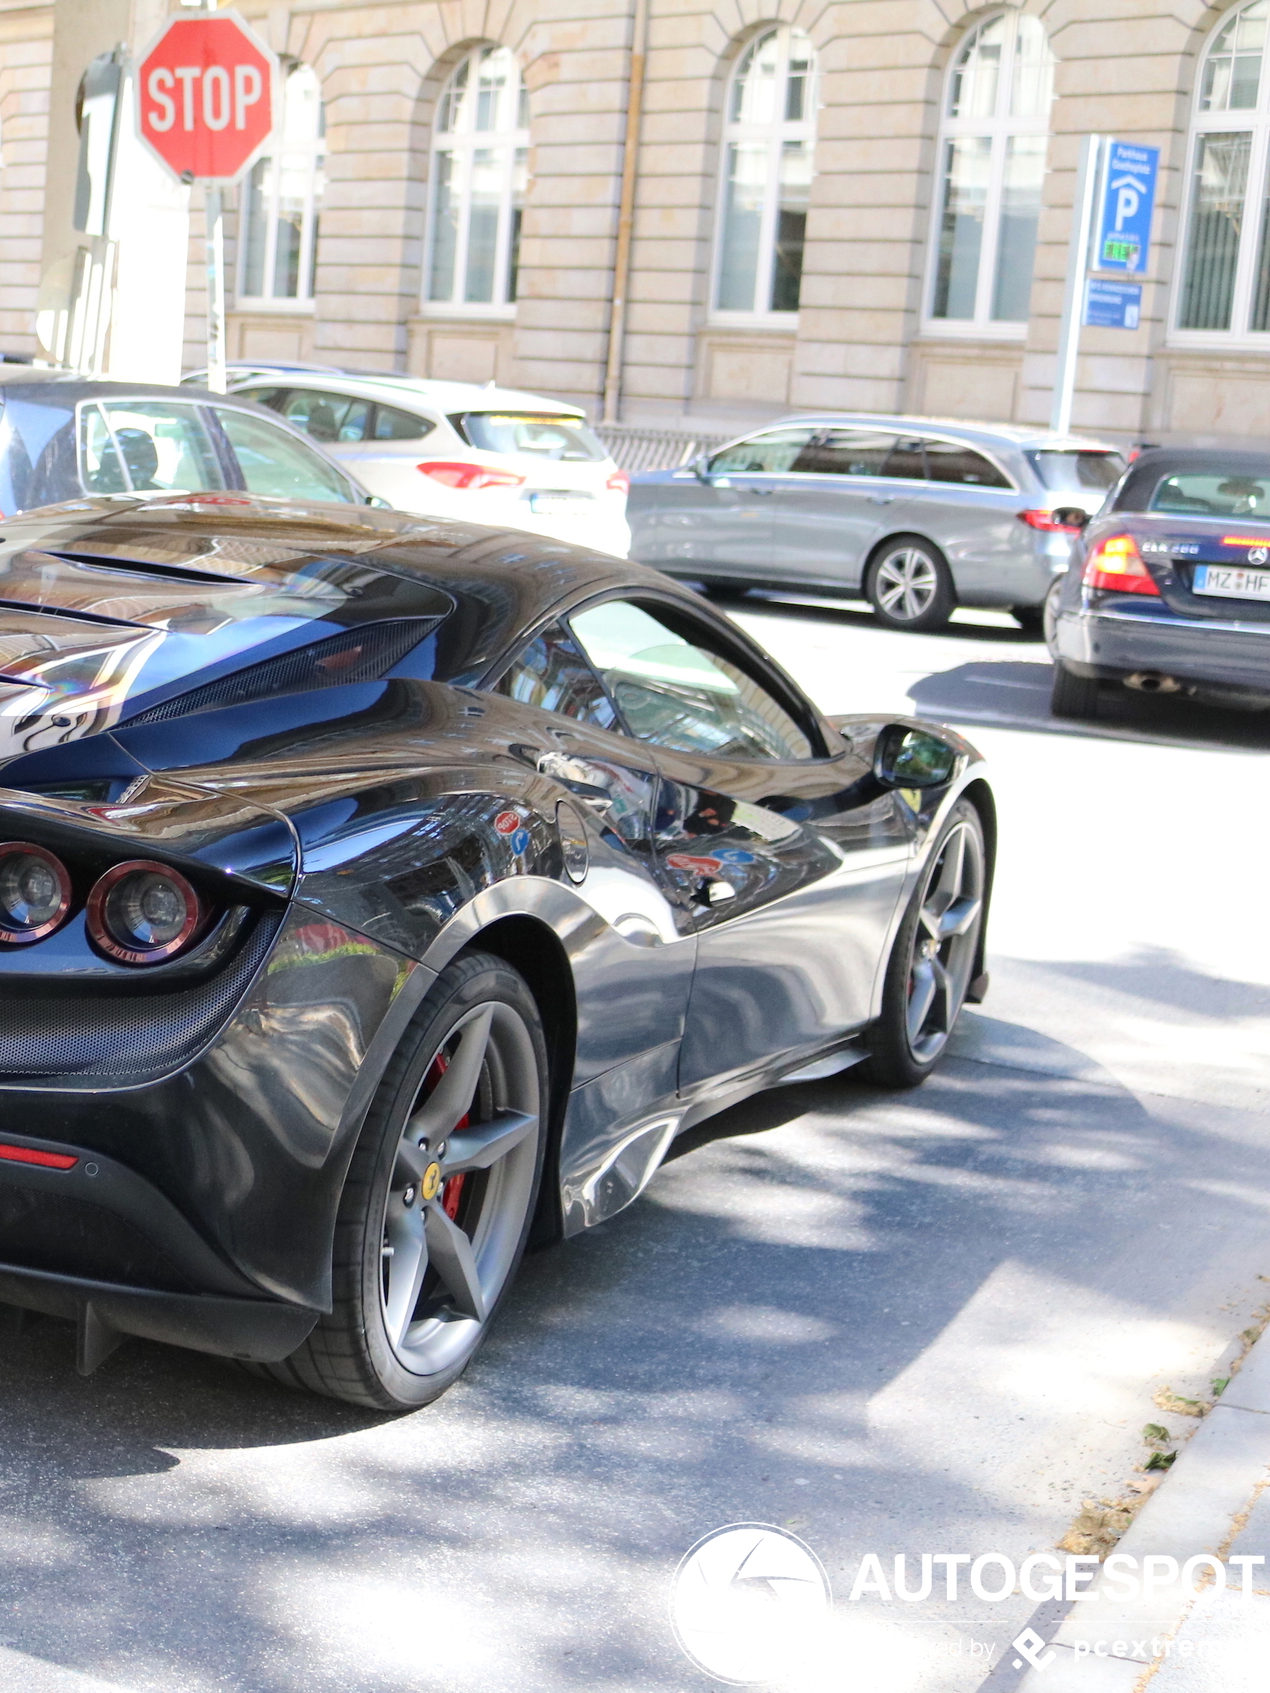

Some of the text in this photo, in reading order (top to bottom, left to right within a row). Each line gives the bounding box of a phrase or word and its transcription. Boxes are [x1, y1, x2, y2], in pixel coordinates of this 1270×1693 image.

[147, 64, 263, 133] STOP
[1115, 187, 1139, 231] P
[1207, 571, 1231, 589] MZ
